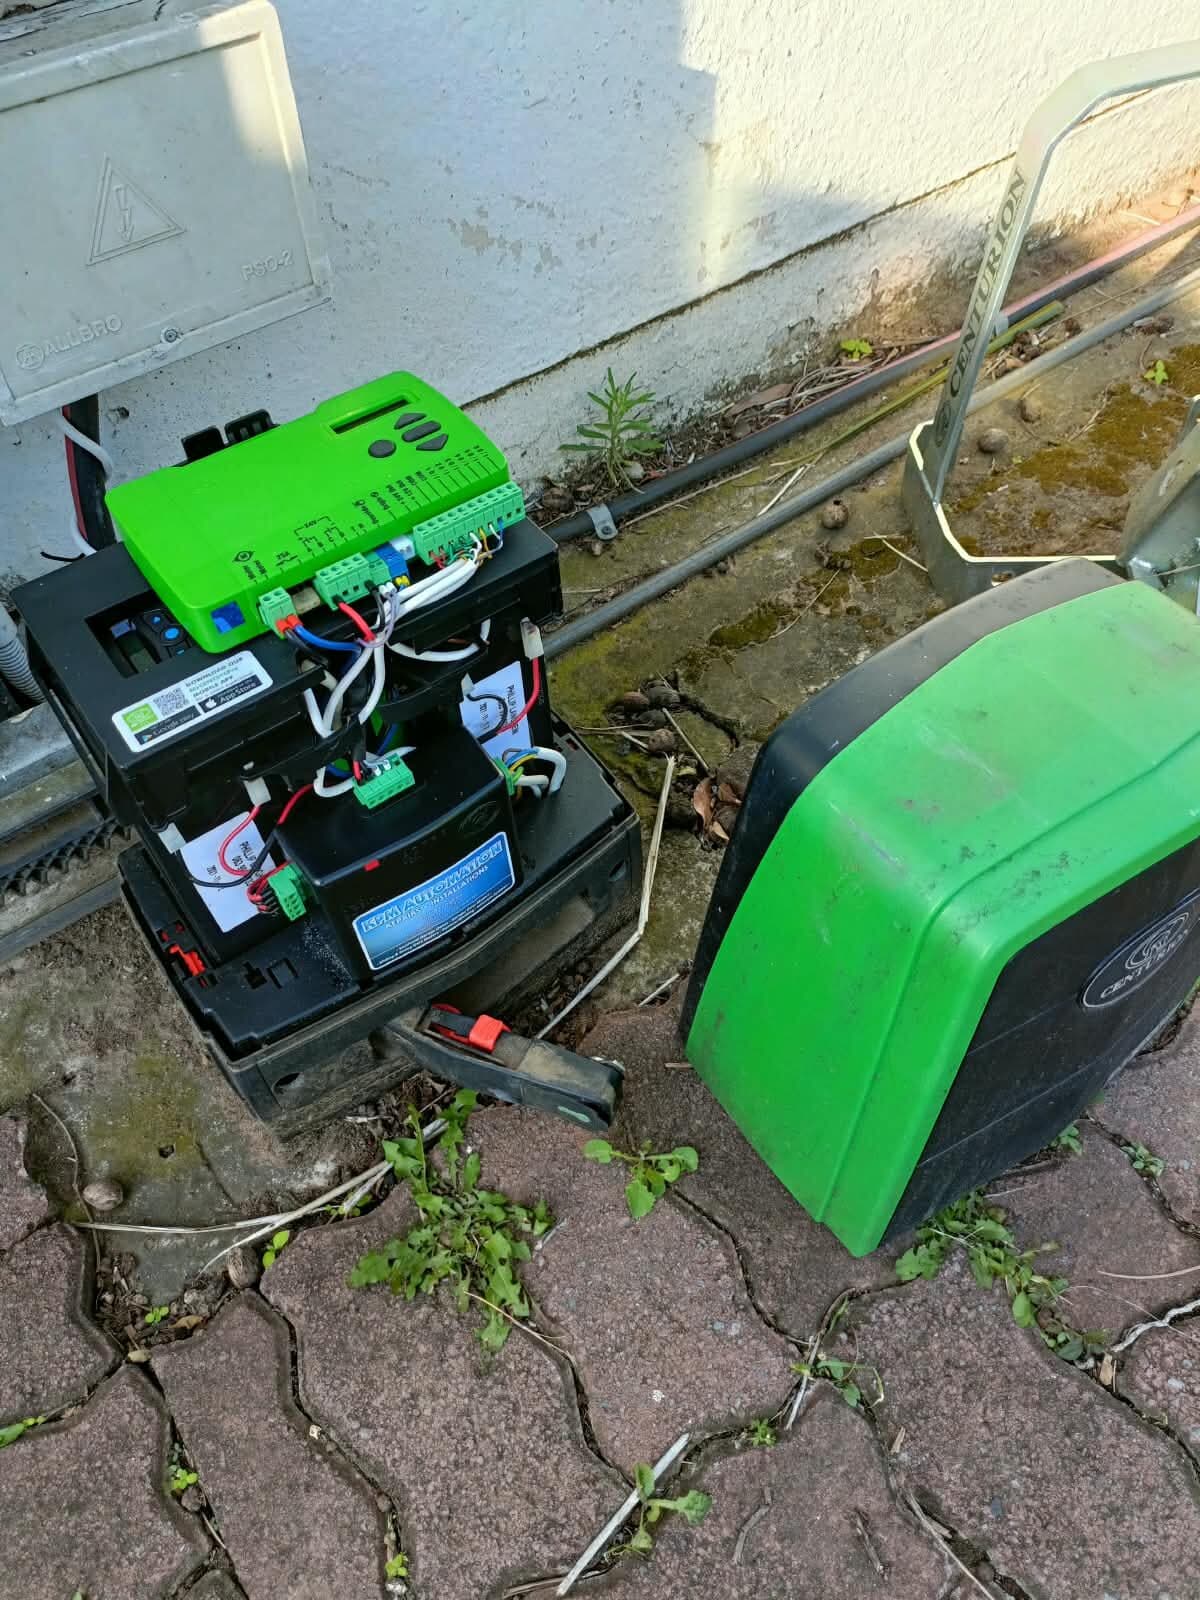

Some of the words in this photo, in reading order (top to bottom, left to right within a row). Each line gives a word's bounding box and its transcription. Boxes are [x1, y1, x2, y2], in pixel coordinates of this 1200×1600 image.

[950, 167, 1025, 398] CENTURION
[43, 313, 123, 353] ALLBRO
[219, 691, 236, 703] App
[235, 681, 256, 696] Store
[401, 840, 503, 912] AUTOMATION
[431, 865, 489, 906] INSTALLATIONS
